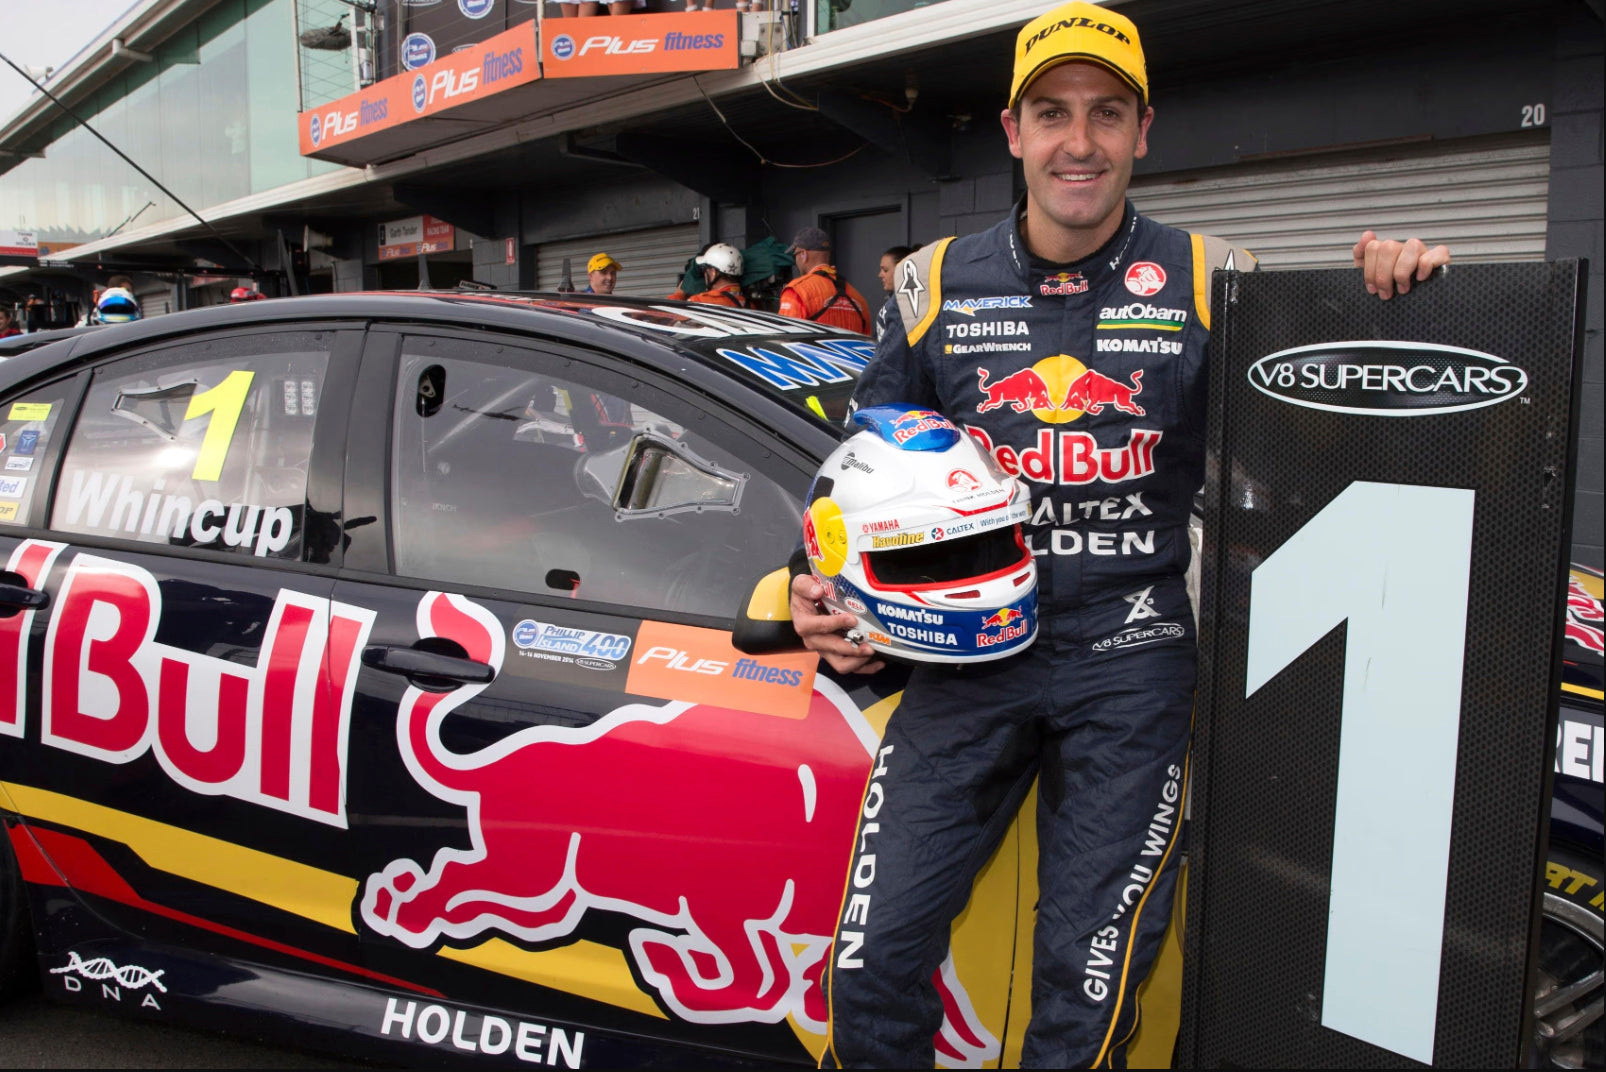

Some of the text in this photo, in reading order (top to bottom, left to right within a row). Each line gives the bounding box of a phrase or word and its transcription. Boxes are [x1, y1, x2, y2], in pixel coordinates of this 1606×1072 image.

[578, 35, 660, 57] Plus
[664, 31, 724, 51] fitness
[1025, 17, 1131, 56] DUNLOP
[428, 67, 481, 105] Plus
[483, 47, 523, 86] fitness
[322, 111, 359, 140] Plus
[360, 98, 388, 127] fitness
[1521, 103, 1546, 128] 20
[693, 207, 700, 220] 21
[1040, 279, 1089, 296] Red Bull
[943, 295, 1033, 311] MAVERICK
[946, 321, 1030, 339] TOSHIBA
[1096, 336, 1183, 355] KOMATSU
[1254, 362, 1513, 395] V8 SUPERCARS
[184, 370, 256, 482] 1
[892, 418, 959, 446] Red Bull
[1058, 428, 1163, 486] Bull
[65, 470, 294, 558] Whincup
[1024, 490, 1154, 527] ALTEX
[869, 518, 900, 532] YAMAHA
[946, 522, 975, 536] CALTEX
[980, 518, 996, 527] With
[996, 517, 1006, 526] you
[872, 530, 925, 549] Havoline
[846, 599, 865, 611] BELL
[877, 603, 944, 626] KOMATSU
[536, 636, 579, 653] ISLAND
[543, 625, 586, 639] PHILLIP
[581, 633, 628, 660] 400
[868, 631, 892, 646] KTM
[887, 622, 958, 646] TOSHIBA
[976, 618, 1028, 648] Red Bull
[1113, 626, 1185, 647] SUPERCARS
[533, 652, 562, 662] NOVEMBER
[637, 646, 803, 687] Plus fitness
[43, 553, 377, 829] Bull
[1246, 480, 1475, 1067] 1
[837, 744, 895, 969] HOLDEN
[1083, 924, 1120, 1002] GIVES
[1140, 764, 1181, 857] WINGS
[64, 975, 161, 1011] DNA
[380, 997, 585, 1070] HOLDEN
